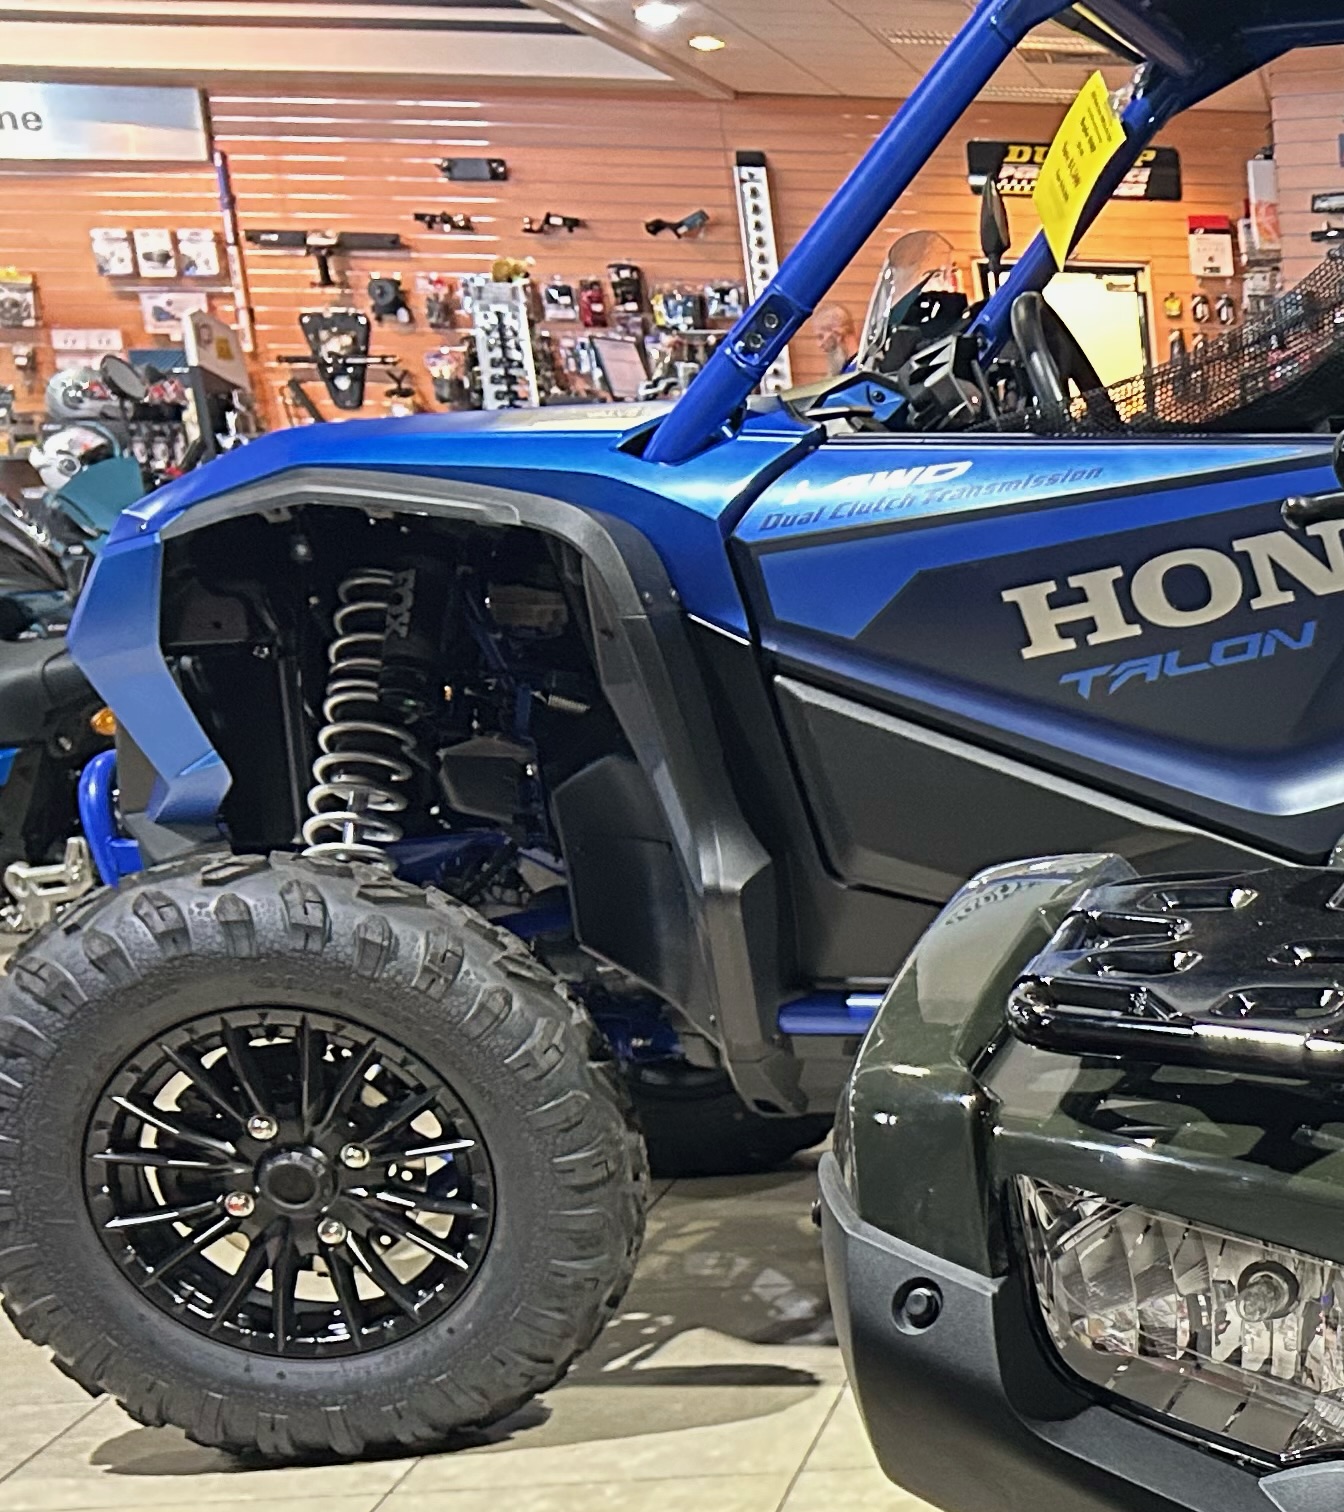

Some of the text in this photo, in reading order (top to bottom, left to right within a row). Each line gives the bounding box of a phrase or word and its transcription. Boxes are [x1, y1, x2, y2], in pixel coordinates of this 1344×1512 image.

[759, 466, 1105, 532] Dual Clutch Transmission
[1059, 620, 1318, 701] TALON
